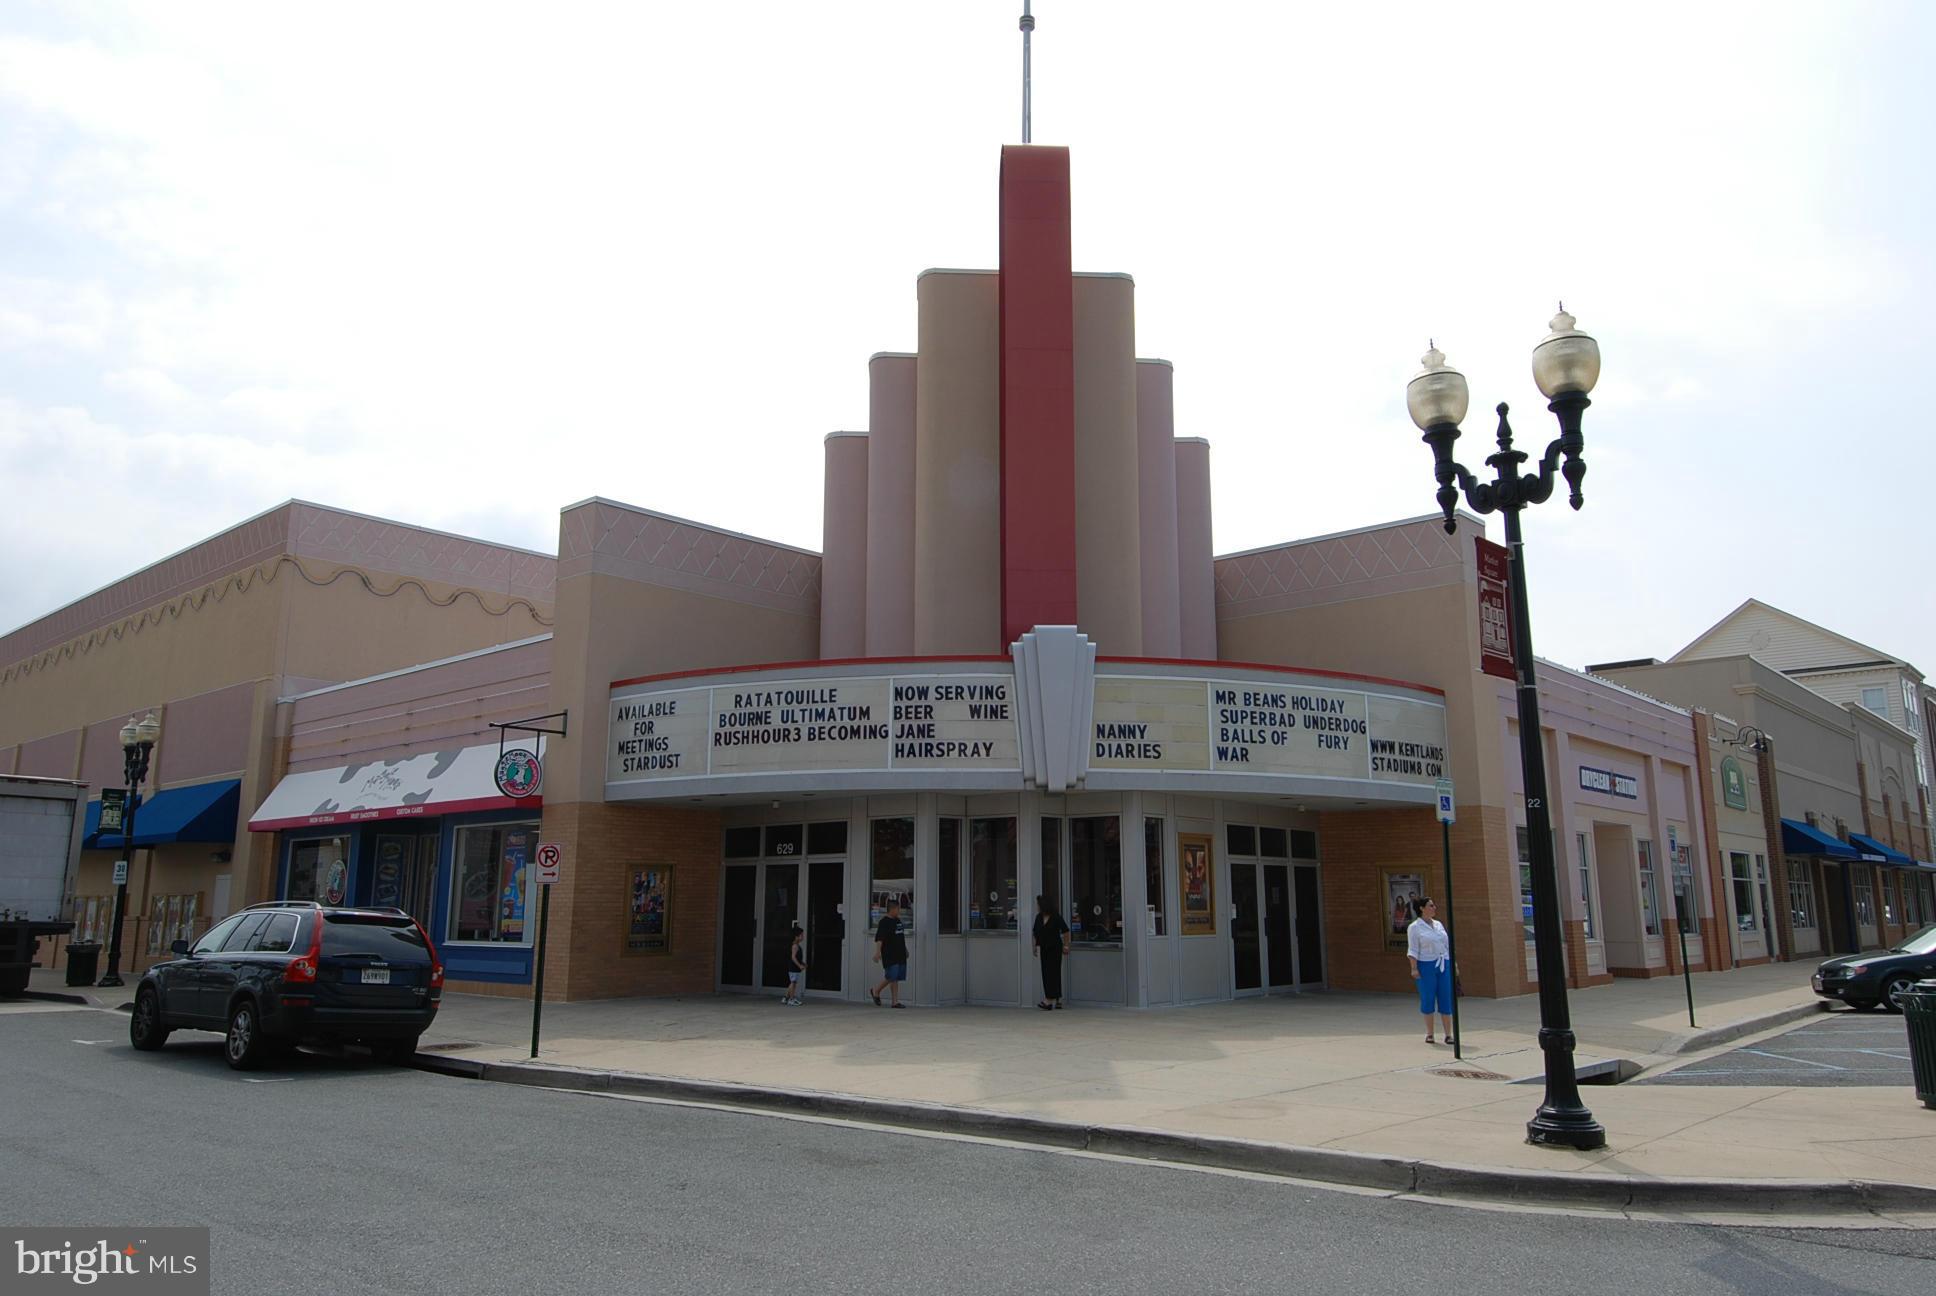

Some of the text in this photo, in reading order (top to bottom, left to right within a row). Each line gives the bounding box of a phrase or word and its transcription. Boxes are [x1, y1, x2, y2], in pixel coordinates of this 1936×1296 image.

[734, 689, 838, 708] RATATOUILLE
[894, 685, 1006, 701] NOW SERVING
[1215, 690, 1345, 714] MR BEANS HOLIDAY
[617, 701, 677, 721] AVAILABLE
[719, 706, 871, 728] BOURNE ULTIMATUM
[893, 704, 1009, 720] BEER WINE
[633, 721, 655, 736] FOR
[1220, 709, 1367, 735] SUPERBAD UNDERDOG
[807, 724, 889, 742] BECOMING
[895, 724, 936, 739] JANE
[1096, 723, 1148, 740] NANNY
[1220, 728, 1350, 750] BALLS OF FURY
[618, 737, 669, 755] MEETINGS
[895, 742, 994, 758] HAIRSPRAY
[1096, 743, 1162, 760] DIARIES
[1216, 746, 1250, 762] WAR
[1370, 739, 1444, 761] WWW KENTLANDS
[623, 754, 681, 773] STARDUST
[1372, 757, 1442, 777] STADIUM8 COM
[1527, 798, 1541, 808] 22
[776, 843, 794, 855] 629
